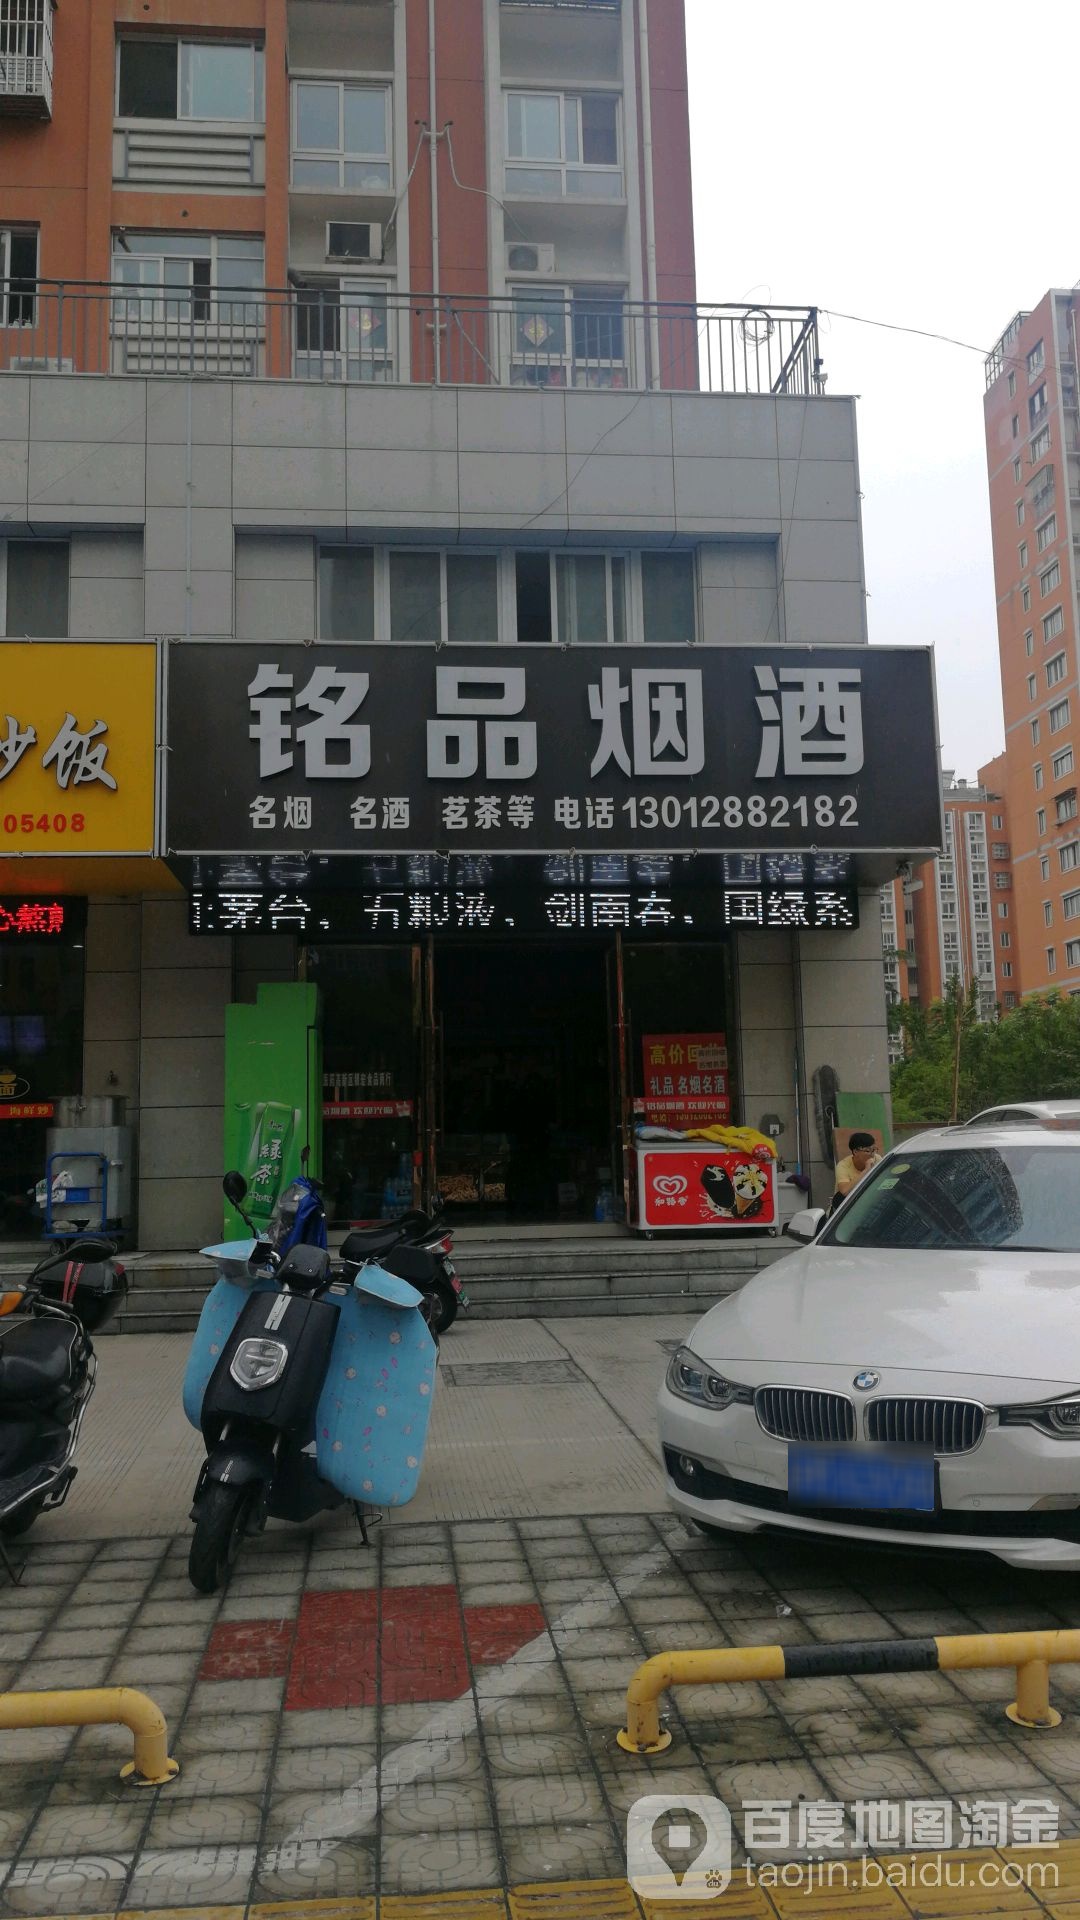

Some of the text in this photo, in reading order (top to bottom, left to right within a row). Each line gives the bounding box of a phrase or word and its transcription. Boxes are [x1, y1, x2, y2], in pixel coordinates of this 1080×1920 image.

[247, 664, 866, 780] 铭品烟酒
[3, 813, 86, 834] 05408
[249, 794, 860, 831] 名烟 名酒 茗茶等 电话 13012882182
[649, 1074, 726, 1096] 礼品 名烟名酒
